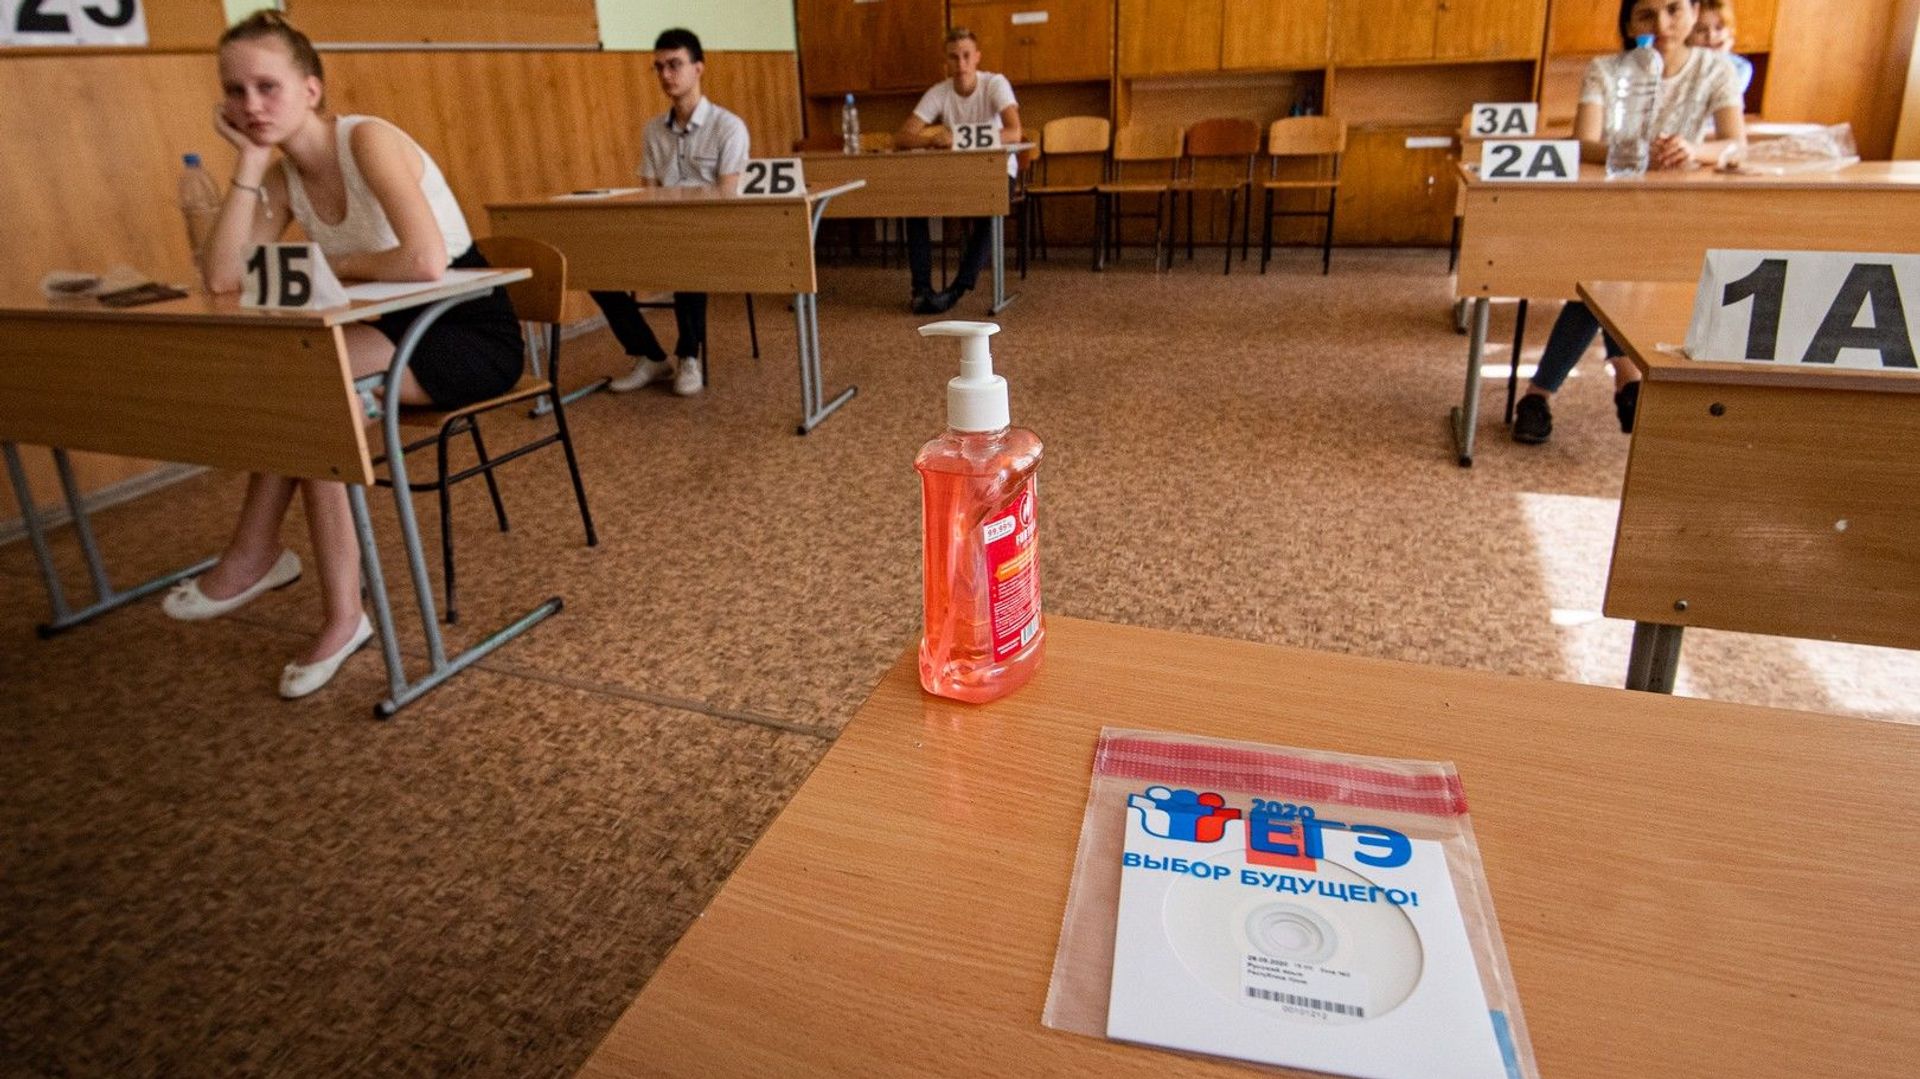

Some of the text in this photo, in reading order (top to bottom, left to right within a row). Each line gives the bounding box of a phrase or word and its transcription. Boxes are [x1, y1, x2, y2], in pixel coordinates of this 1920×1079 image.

[957, 125, 994, 149] 3Б
[1477, 107, 1528, 134] 3А
[1489, 144, 1567, 178] 2А
[743, 162, 796, 195] 2Б
[247, 245, 311, 307] 1Б
[1722, 259, 1918, 368] 1А
[1251, 798, 1316, 821] 2020
[1249, 811, 1413, 868] ЕГЭ
[1122, 851, 1420, 907] ВЫБОР БУДУЩЕГО!
